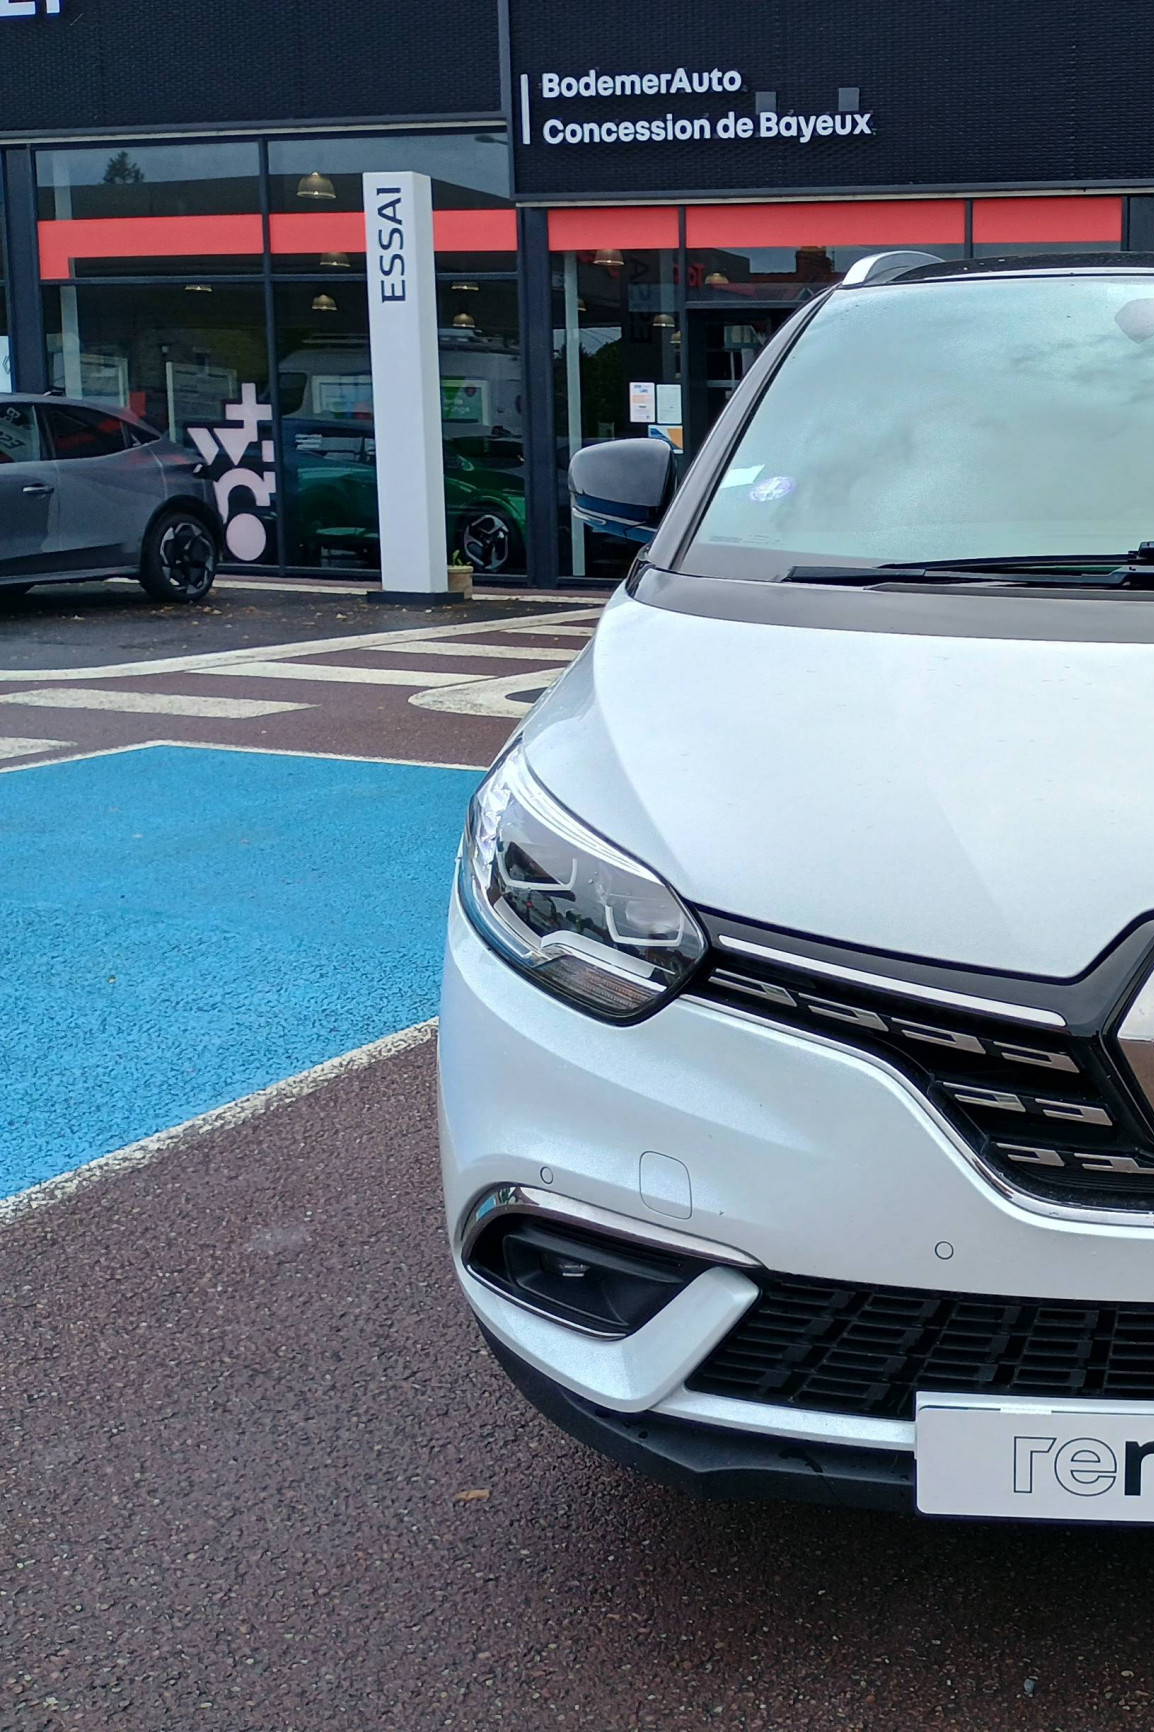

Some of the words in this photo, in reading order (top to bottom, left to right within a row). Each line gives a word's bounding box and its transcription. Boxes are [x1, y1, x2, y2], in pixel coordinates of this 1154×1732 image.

[541, 67, 742, 98] BodemerAuto
[543, 114, 711, 144] Concession
[716, 112, 753, 138] de
[759, 111, 872, 143] Bayeux
[376, 187, 406, 303] ESSAI
